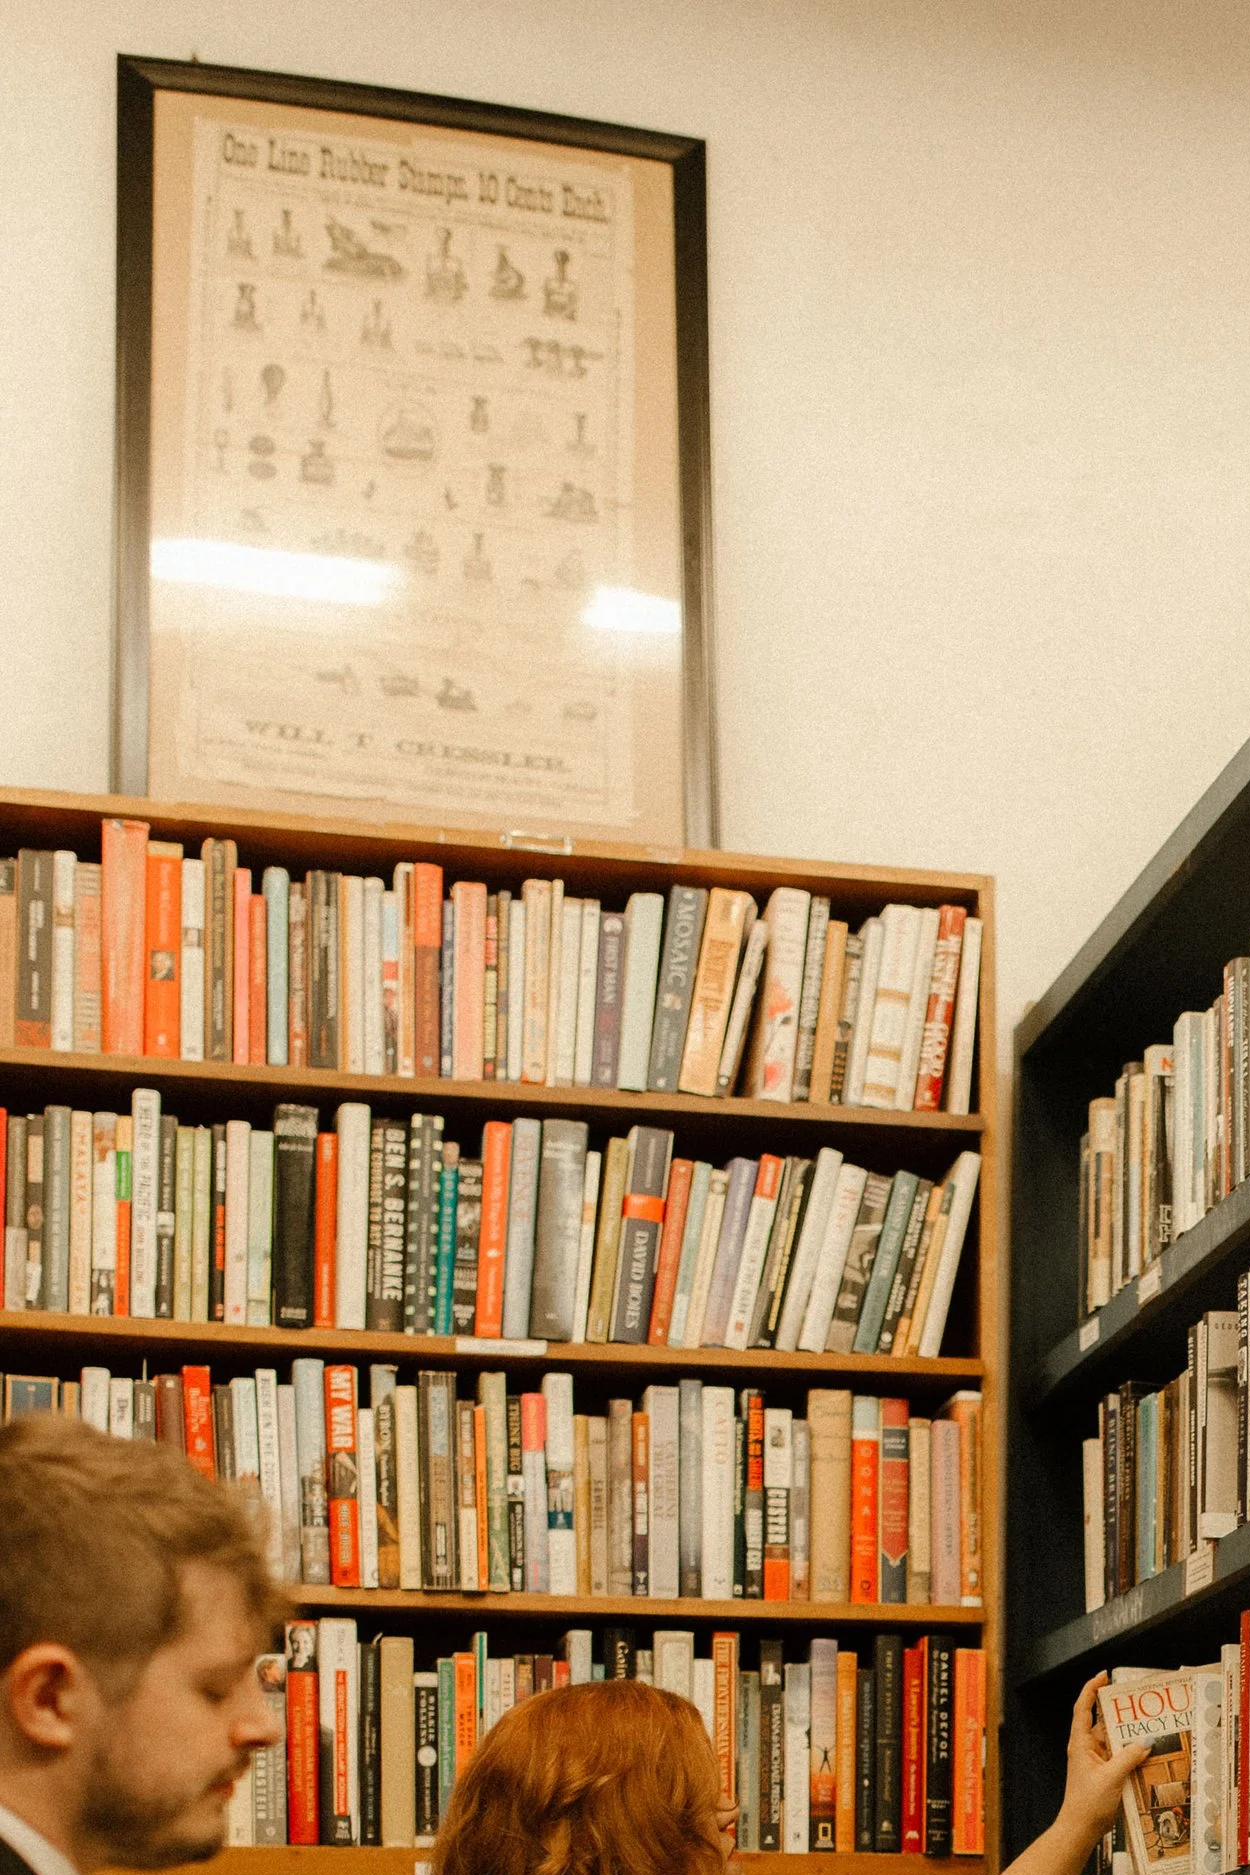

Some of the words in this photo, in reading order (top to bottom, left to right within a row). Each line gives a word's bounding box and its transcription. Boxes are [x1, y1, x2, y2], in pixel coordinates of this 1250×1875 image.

[223, 133, 259, 165] One
[267, 137, 310, 176] Line
[319, 145, 390, 188] Rubber
[478, 170, 498, 204] 10
[603, 935, 620, 969] FIRST
[669, 902, 697, 988] MOSAIC
[602, 971, 618, 1005] MAN
[373, 1128, 384, 1149] THE
[385, 1128, 405, 1167] BEN
[384, 1172, 404, 1190] S.
[382, 1197, 404, 1301] BERNANKE
[630, 1230, 651, 1281] DAVID
[330, 1370, 353, 1400] MY
[331, 1404, 354, 1449] WAR
[380, 1404, 394, 1453] BYRON
[510, 1403, 522, 1445] THINK
[510, 1448, 522, 1471] BIG
[666, 1440, 679, 1520] CATHERINE
[767, 1487, 787, 1544] CUSTER
[939, 1651, 949, 1705] DANIEL
[770, 1703, 781, 1734] DIANA
[863, 1681, 872, 1729] mothers
[938, 1711, 948, 1760] DEFOE
[1116, 1714, 1169, 1740] TRACY
[770, 1743, 780, 1788] MICHAEL
[859, 1738, 872, 1775] sparta
[769, 1786, 780, 1825] PRESTON
